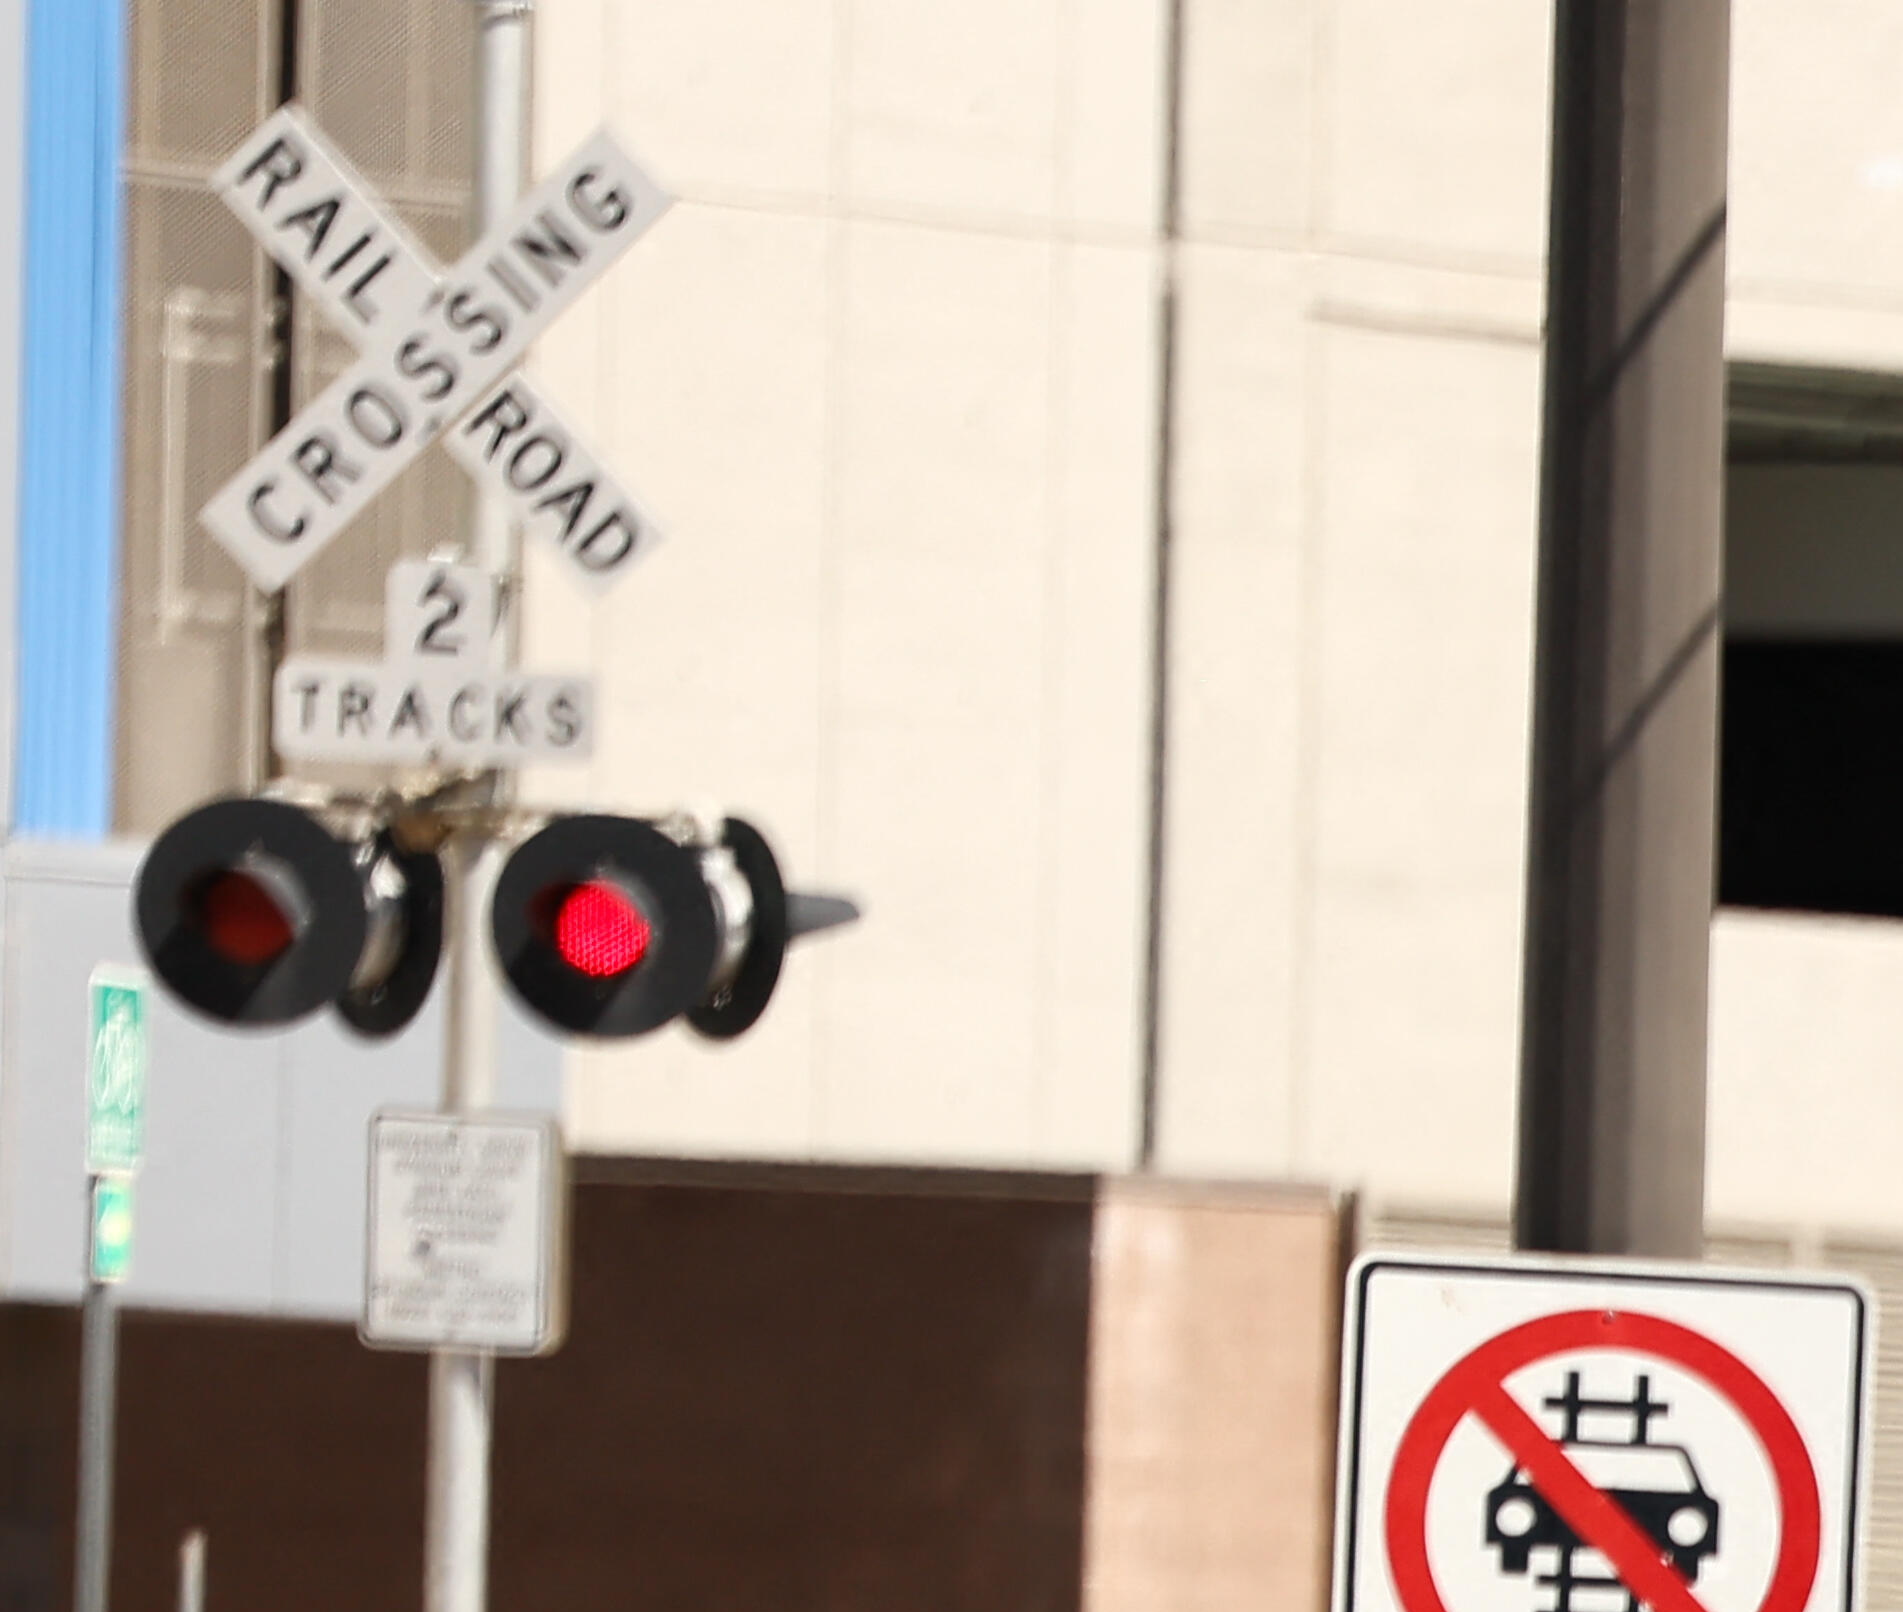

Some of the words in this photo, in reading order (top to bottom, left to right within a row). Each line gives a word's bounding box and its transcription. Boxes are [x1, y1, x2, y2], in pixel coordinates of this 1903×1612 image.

[240, 136, 401, 326] RAIL
[463, 386, 640, 580] ROAD
[245, 162, 632, 547] CROSSING
[289, 680, 586, 748] TRACKS
[416, 570, 462, 655] 2
